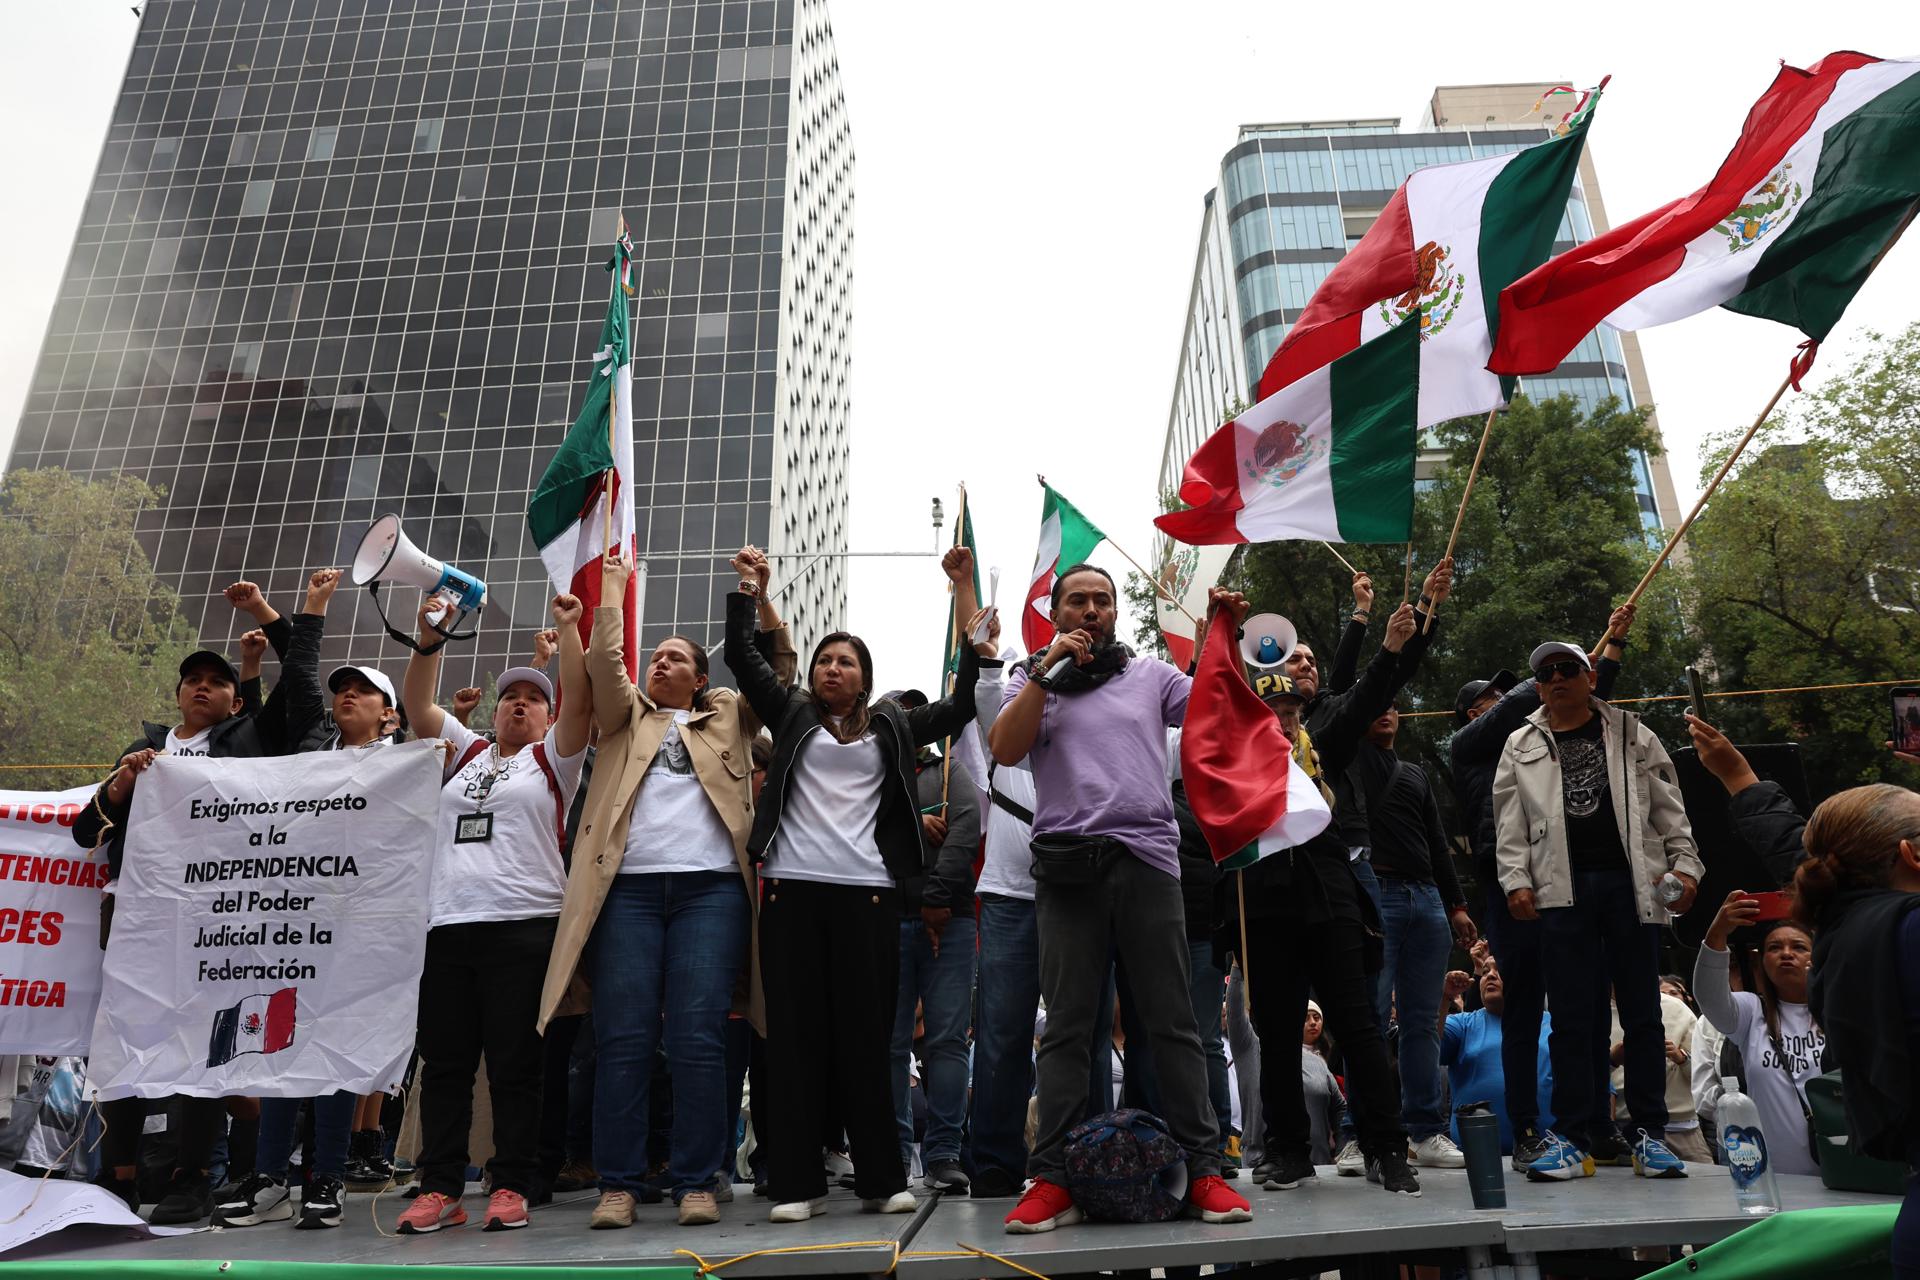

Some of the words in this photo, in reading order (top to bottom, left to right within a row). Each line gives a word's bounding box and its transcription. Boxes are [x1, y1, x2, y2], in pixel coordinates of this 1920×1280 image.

[1255, 674, 1293, 696] PJF
[0, 802, 91, 828] TICO
[190, 797, 279, 822] Exigimos
[283, 793, 367, 817] respeto
[248, 832, 262, 846] a
[267, 825, 287, 846] la
[184, 855, 359, 884] INDEPENDENCIA
[212, 891, 242, 913] del
[247, 889, 315, 912] Poder
[194, 923, 266, 948] Judicial
[272, 923, 303, 945] de
[310, 922, 332, 945] la
[198, 957, 316, 982] Federación
